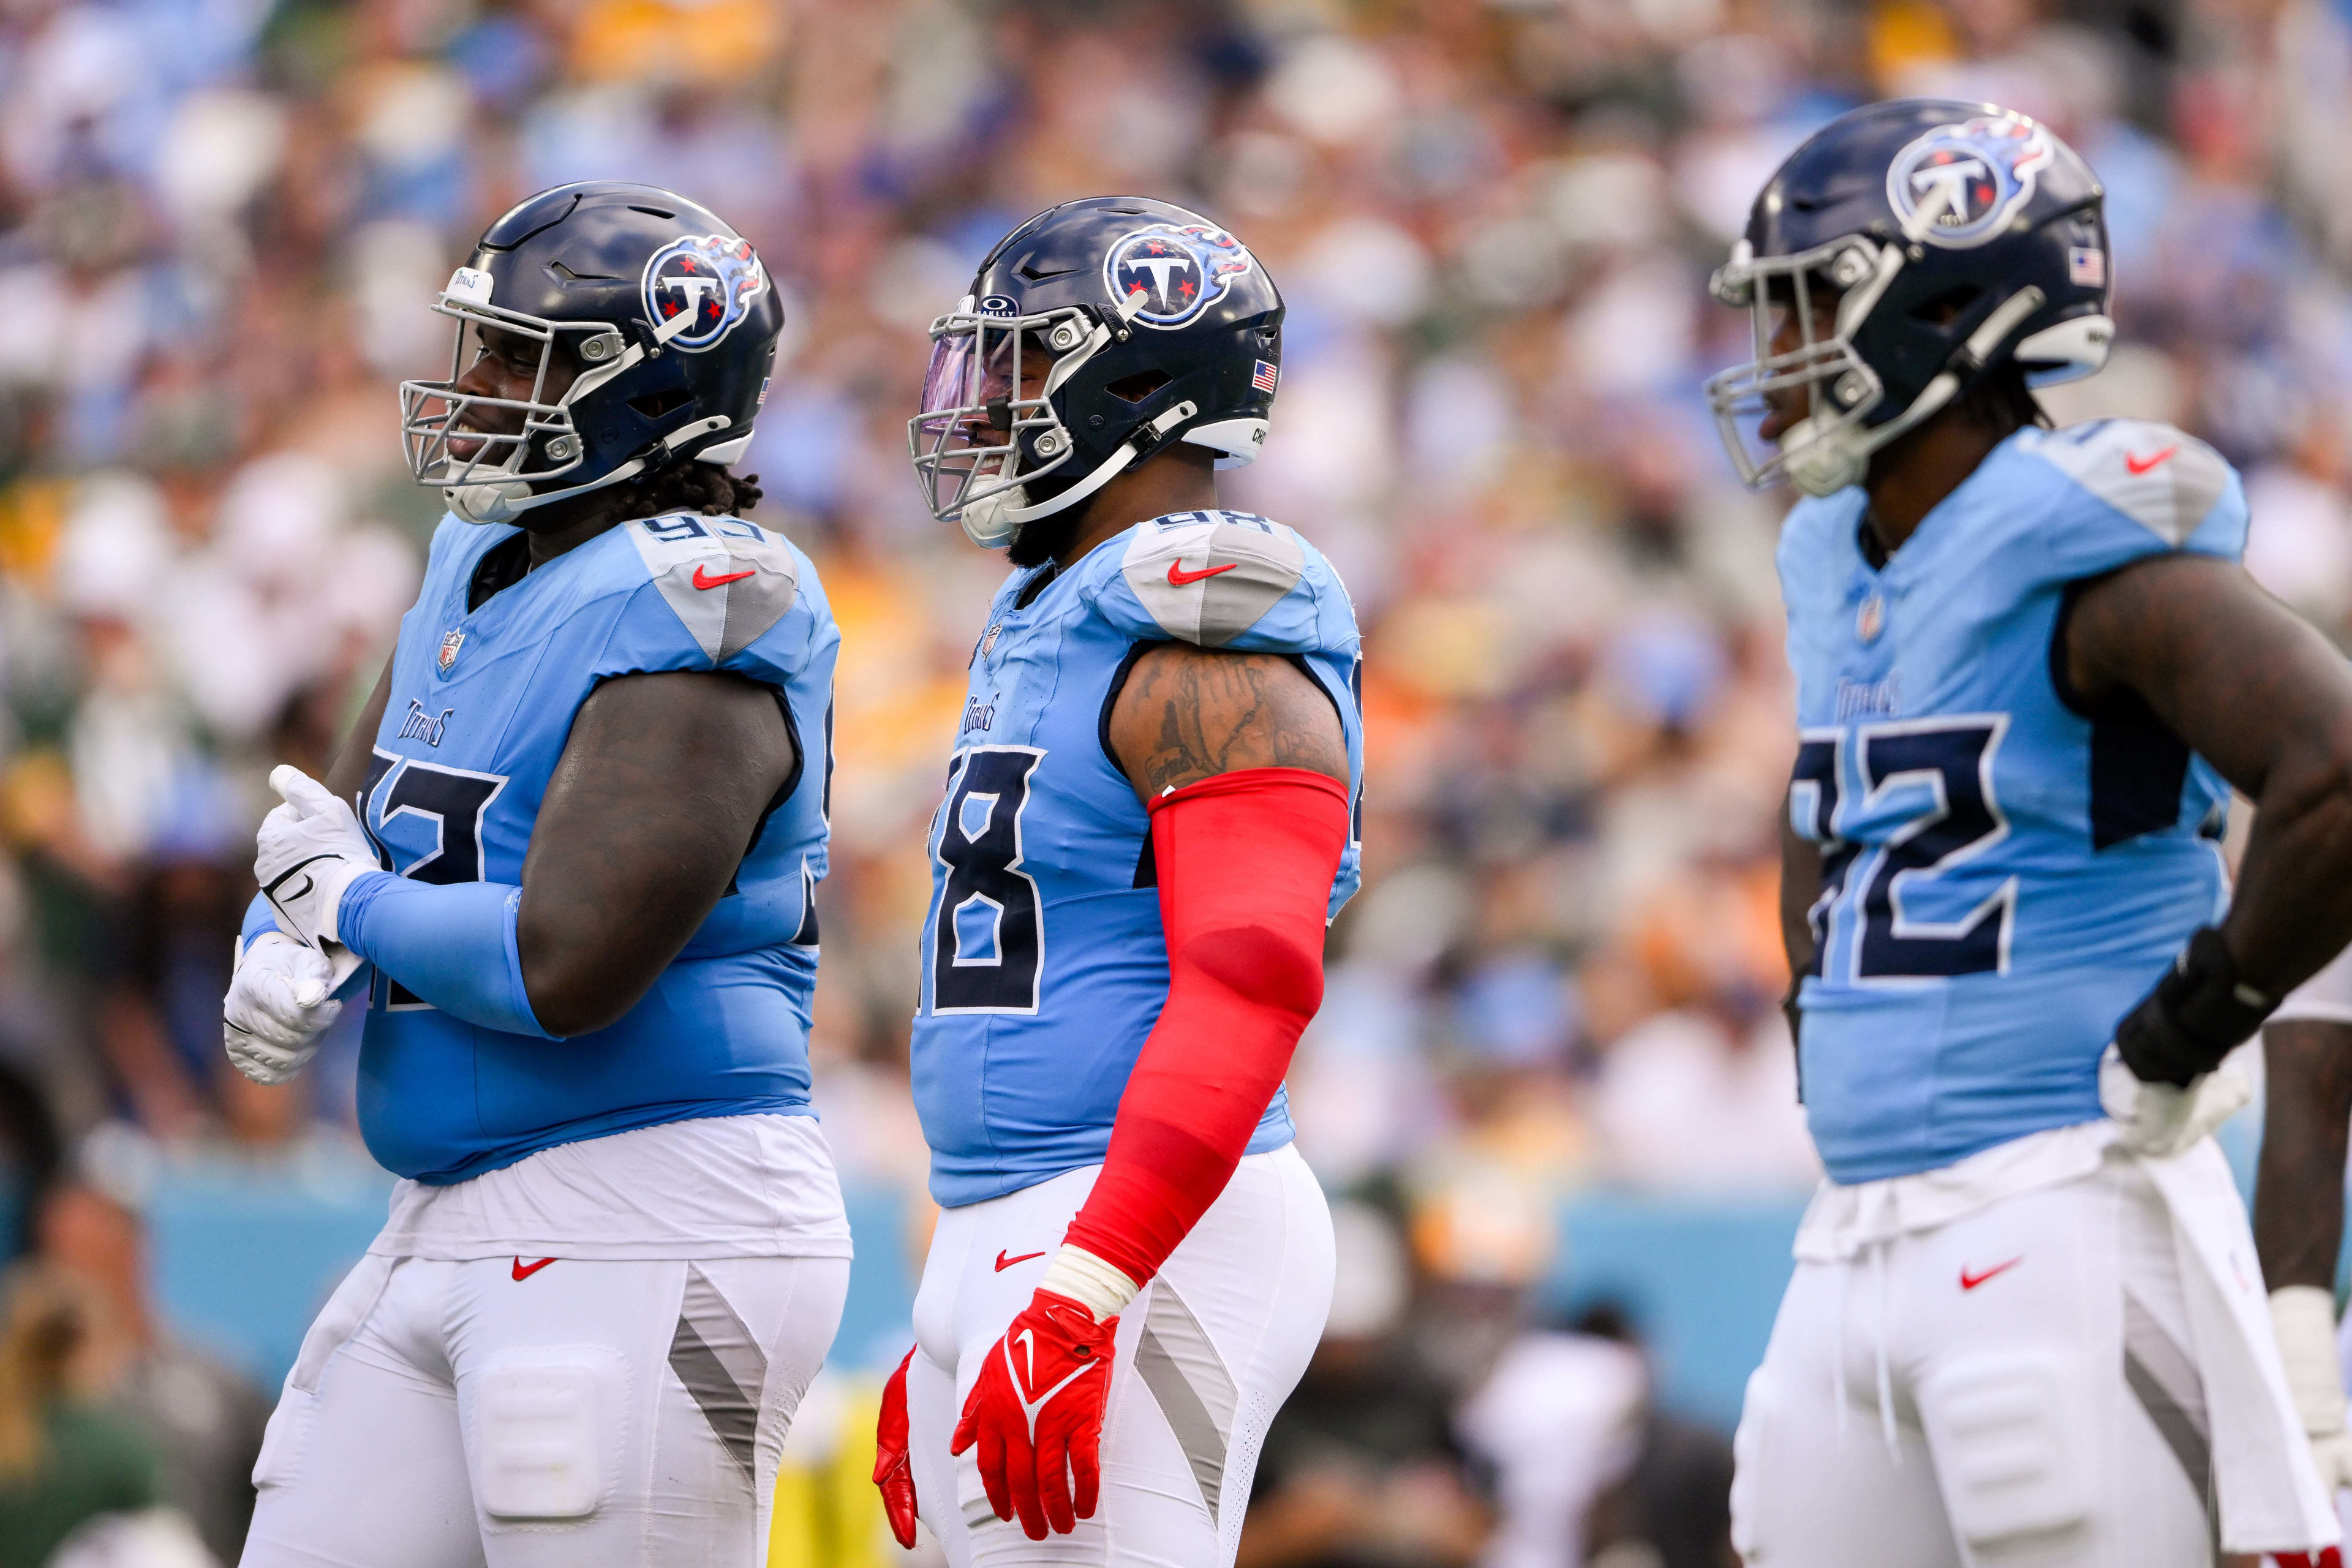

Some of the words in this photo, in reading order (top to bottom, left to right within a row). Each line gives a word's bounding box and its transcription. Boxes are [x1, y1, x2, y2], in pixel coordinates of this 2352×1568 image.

[440, 646, 454, 663] NFL
[397, 698, 456, 748] TITANS
[964, 690, 1000, 735] TITANS
[916, 744, 1049, 1017] 8
